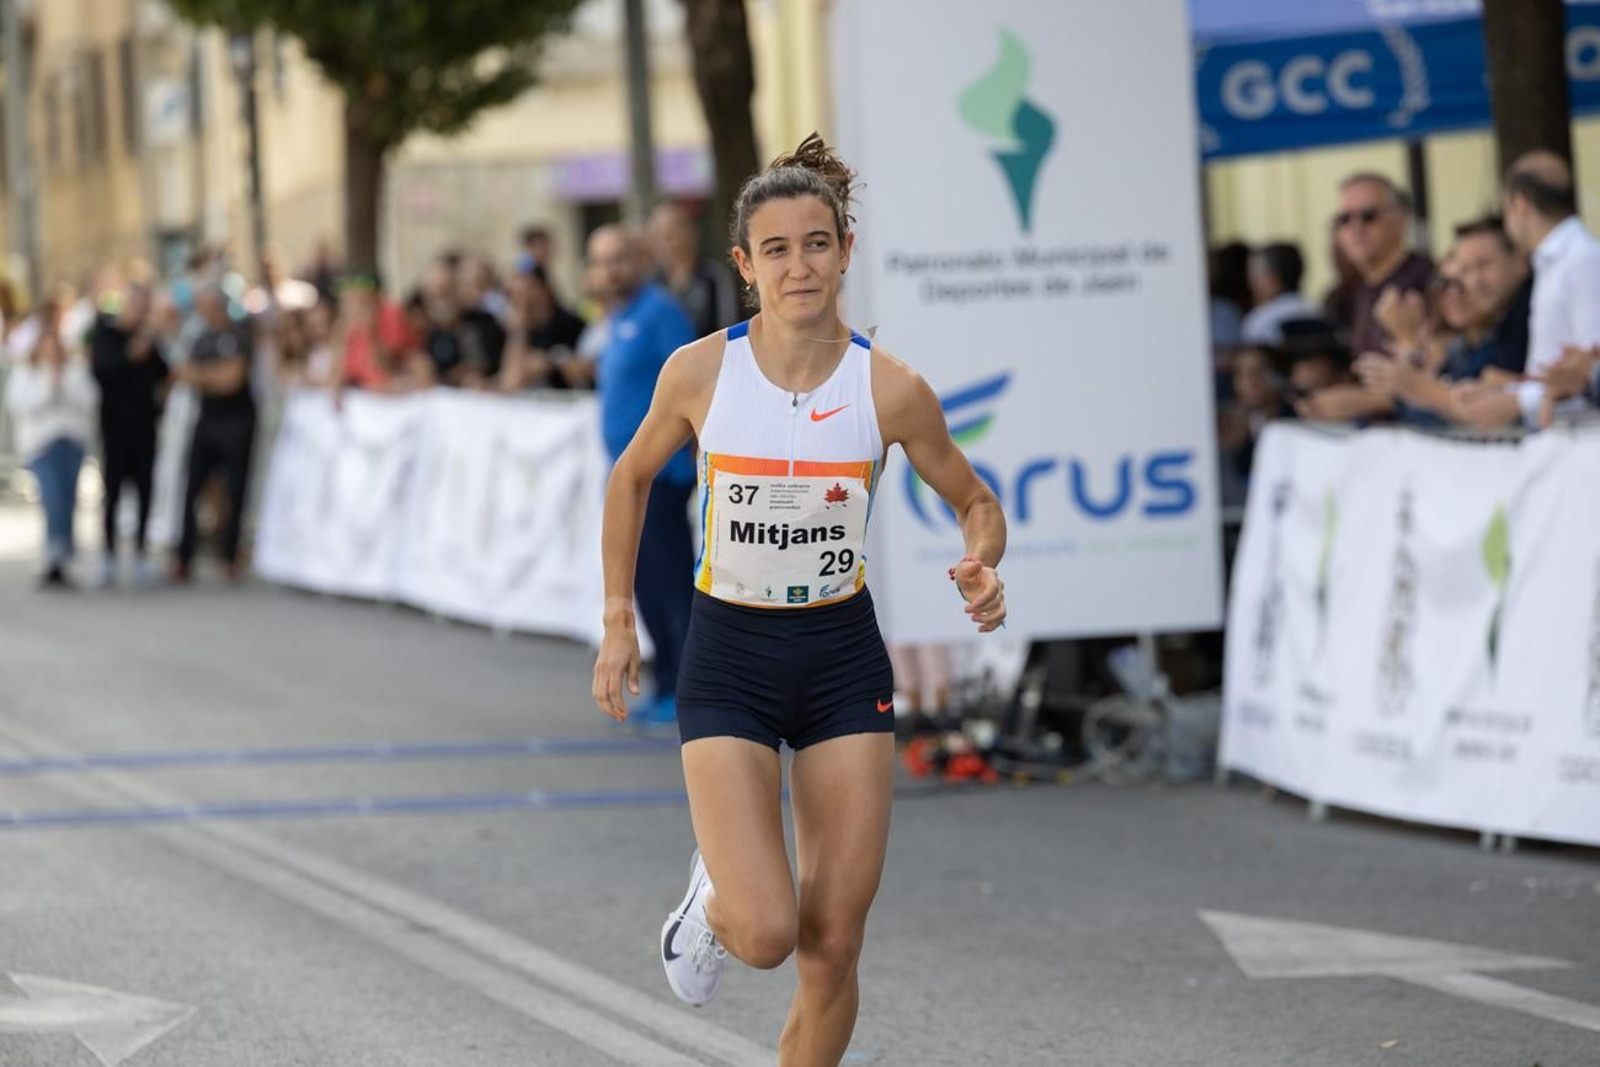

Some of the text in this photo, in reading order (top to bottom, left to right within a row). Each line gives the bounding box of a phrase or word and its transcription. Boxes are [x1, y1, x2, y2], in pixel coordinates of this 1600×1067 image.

[1221, 49, 1376, 120] GCC
[728, 484, 759, 505] 37
[730, 520, 846, 550] Mitjans
[818, 548, 855, 577] 29
